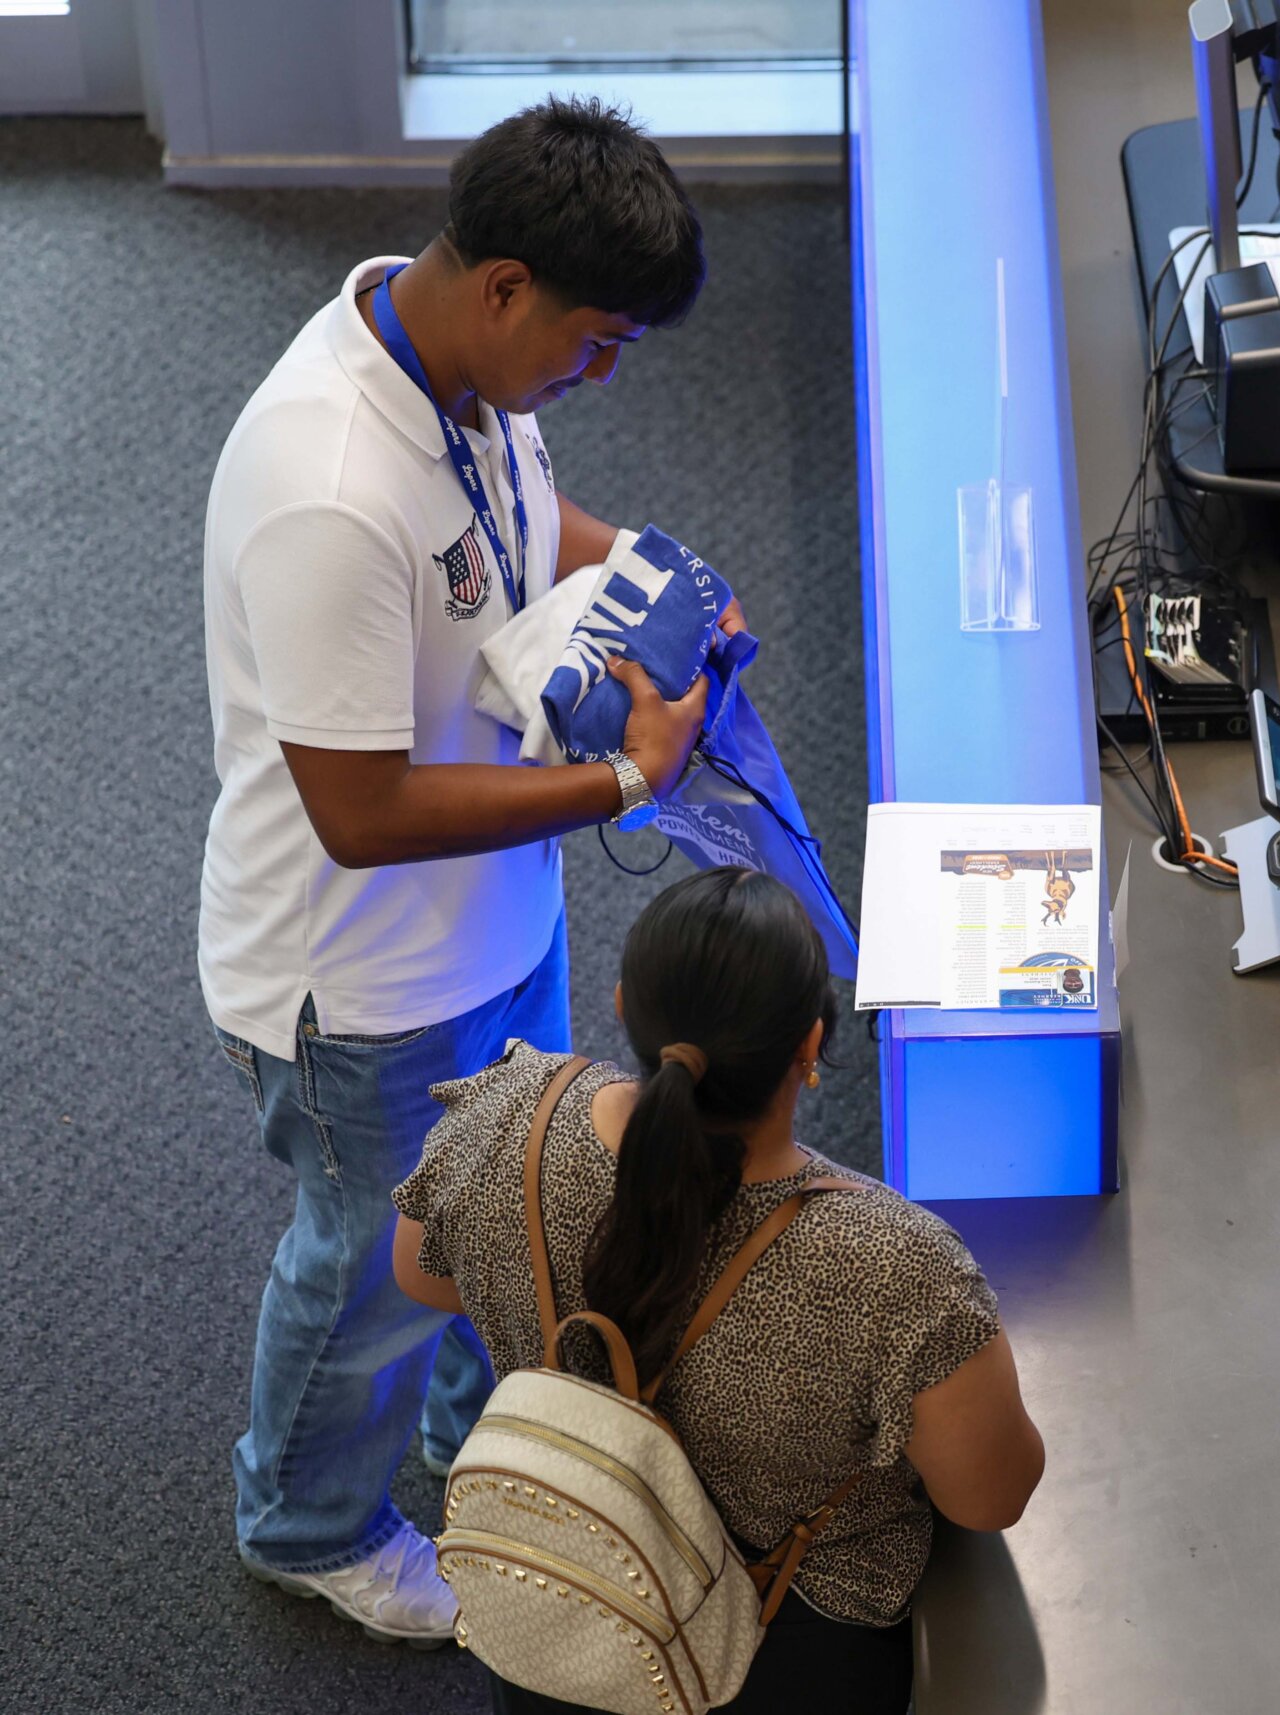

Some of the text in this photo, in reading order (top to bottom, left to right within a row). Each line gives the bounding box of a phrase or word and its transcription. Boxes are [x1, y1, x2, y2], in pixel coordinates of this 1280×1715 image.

[443, 416, 462, 446] Lopers
[461, 463, 479, 492] Lopers
[481, 509, 497, 537] Lopers
[498, 553, 511, 580] Lopers
[1063, 993, 1092, 1004] UNK
